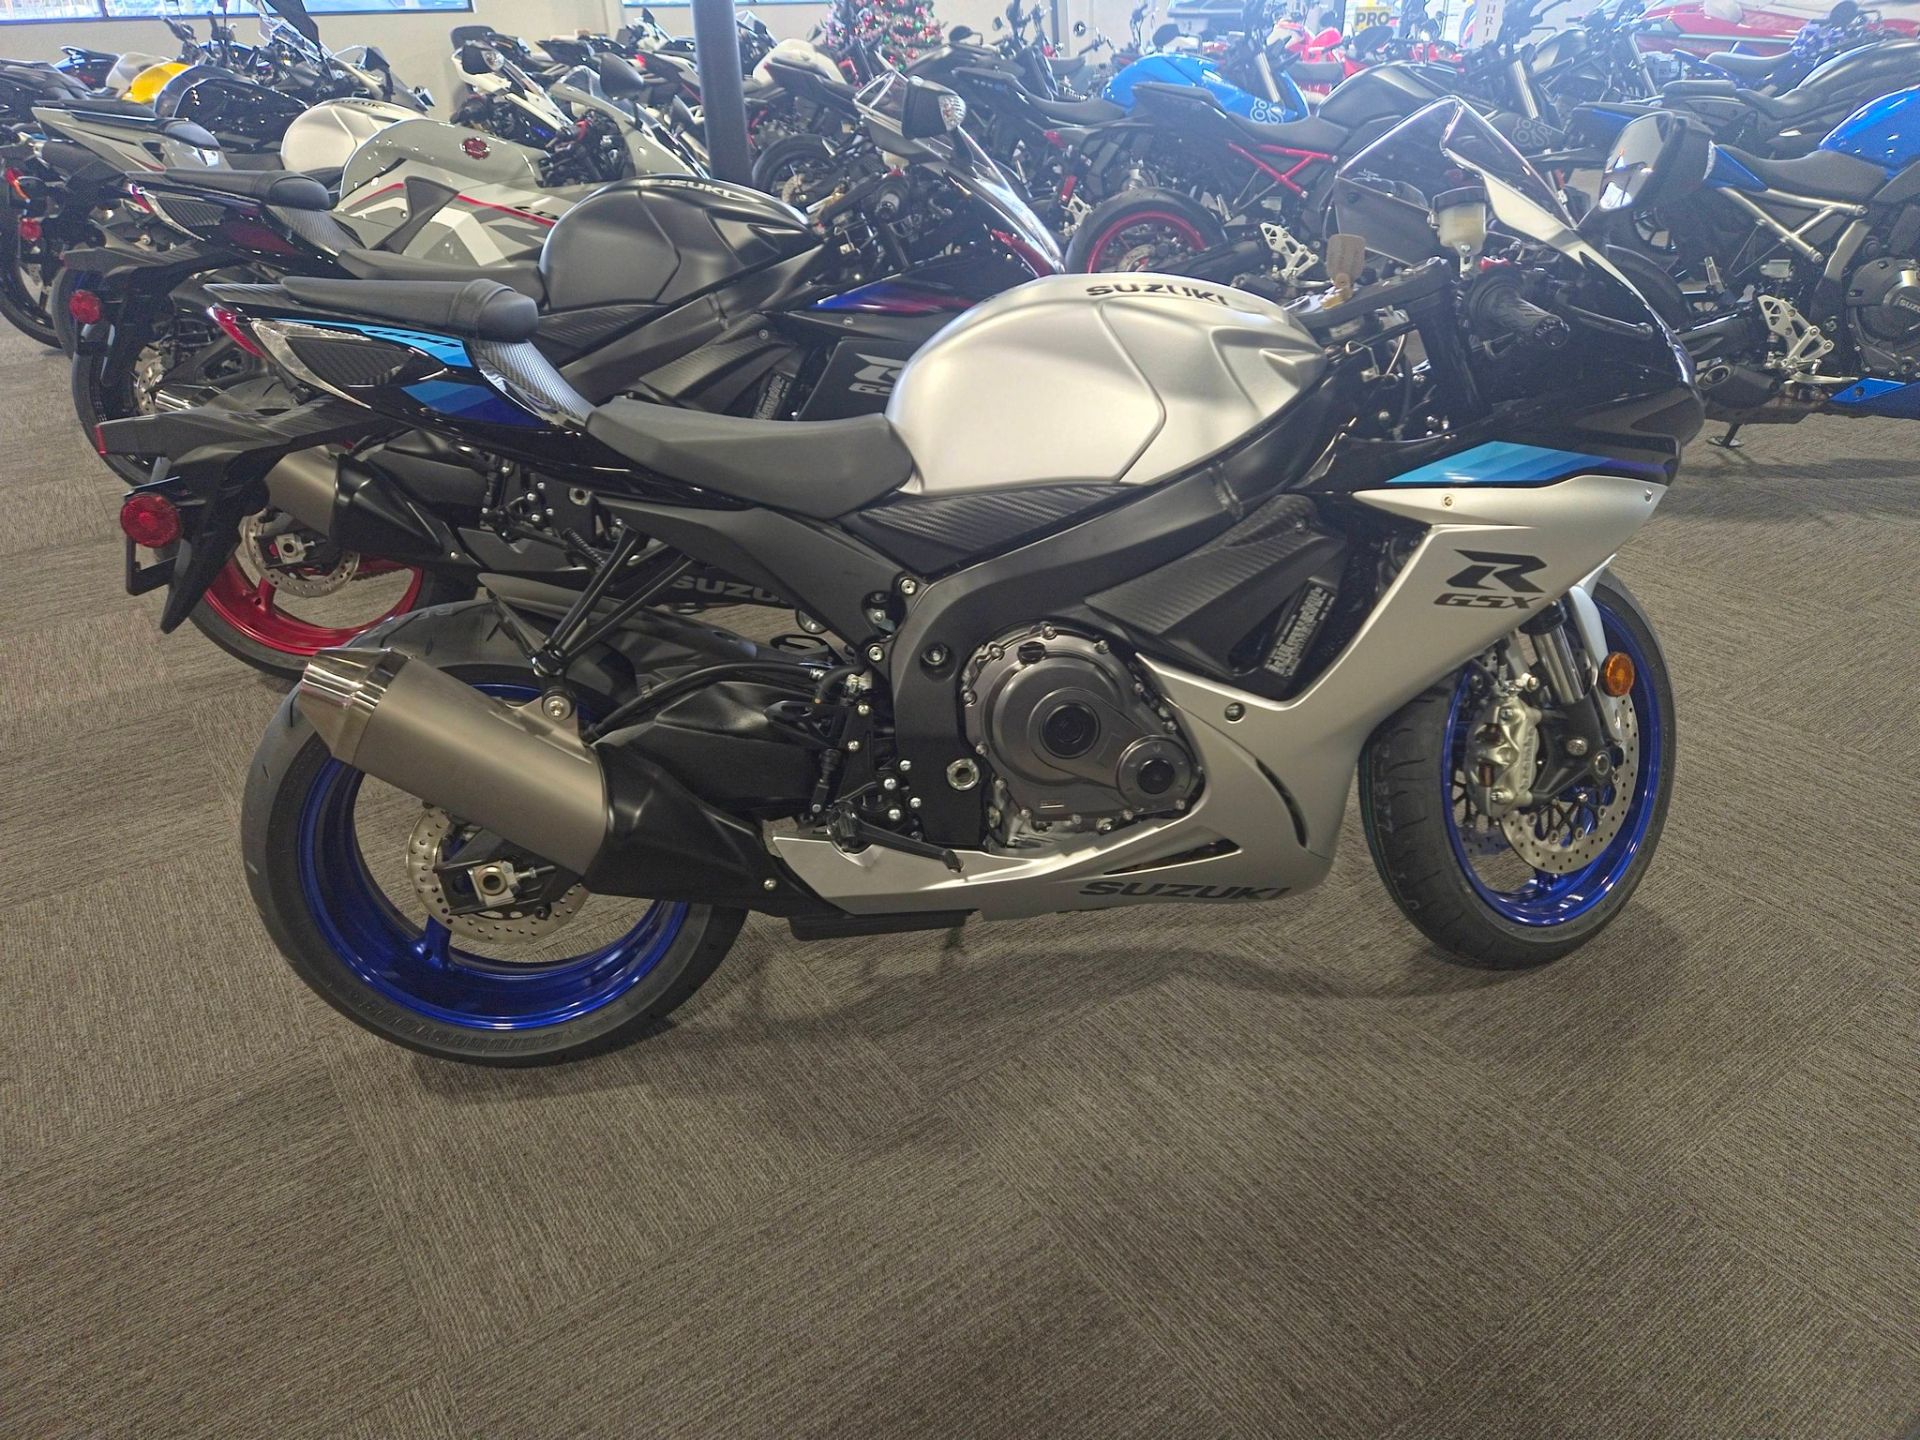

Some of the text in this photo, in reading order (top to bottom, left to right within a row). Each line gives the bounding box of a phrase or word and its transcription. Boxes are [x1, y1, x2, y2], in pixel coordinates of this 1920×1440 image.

[1356, 11, 1390, 27] PRO
[1086, 284, 1229, 306] SUZUKI
[1446, 549, 1548, 593] R
[672, 575, 785, 603] SUZU
[1434, 592, 1543, 609] GSX
[1080, 881, 1292, 900] SUZUKI
